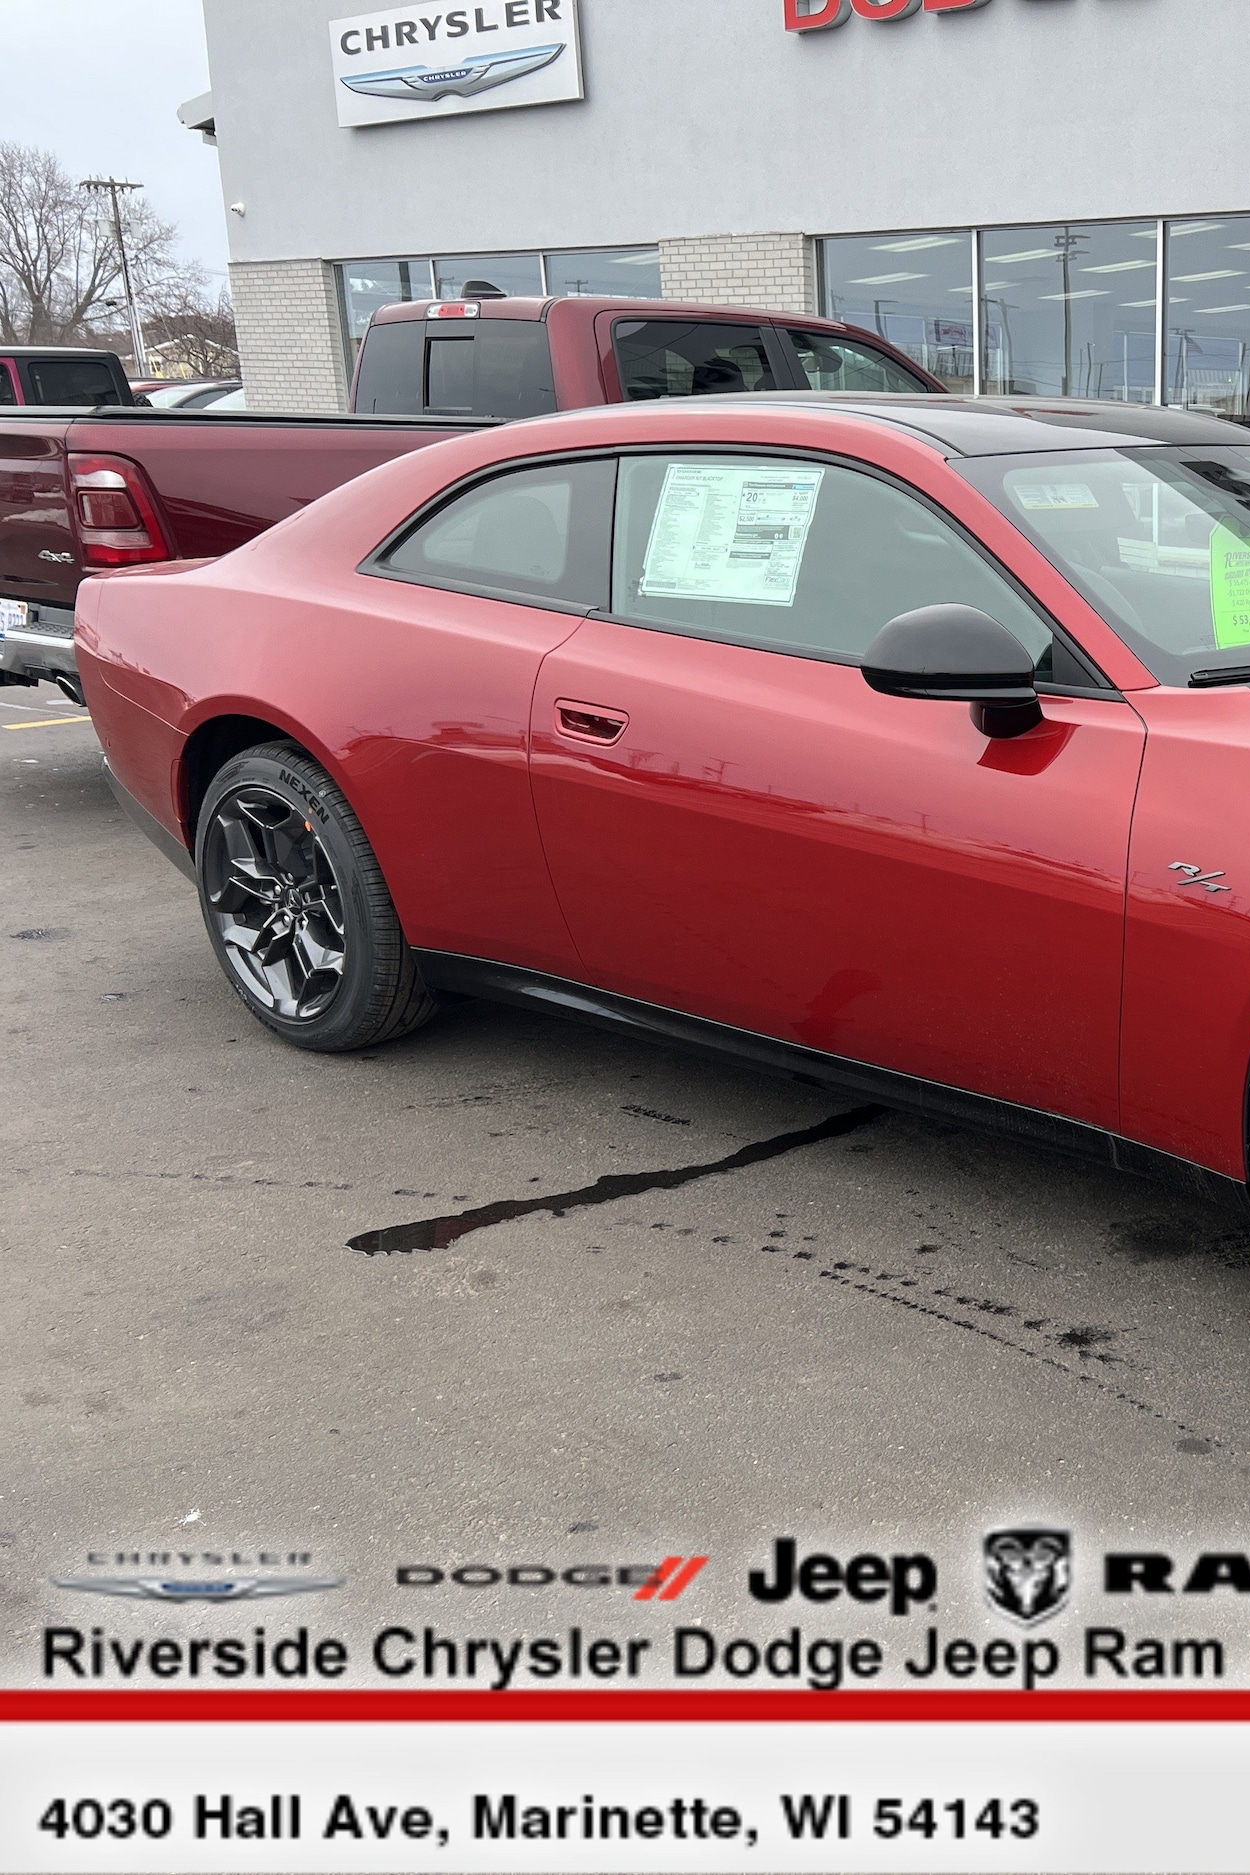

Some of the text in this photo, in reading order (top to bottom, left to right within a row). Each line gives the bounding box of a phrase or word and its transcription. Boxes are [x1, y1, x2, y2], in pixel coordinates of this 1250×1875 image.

[340, 0, 562, 55] CHRYSLER
[423, 70, 467, 82] CHRYSLER
[746, 492, 759, 503] 20
[279, 769, 330, 825] NEXEN
[1168, 861, 1232, 892] R/T
